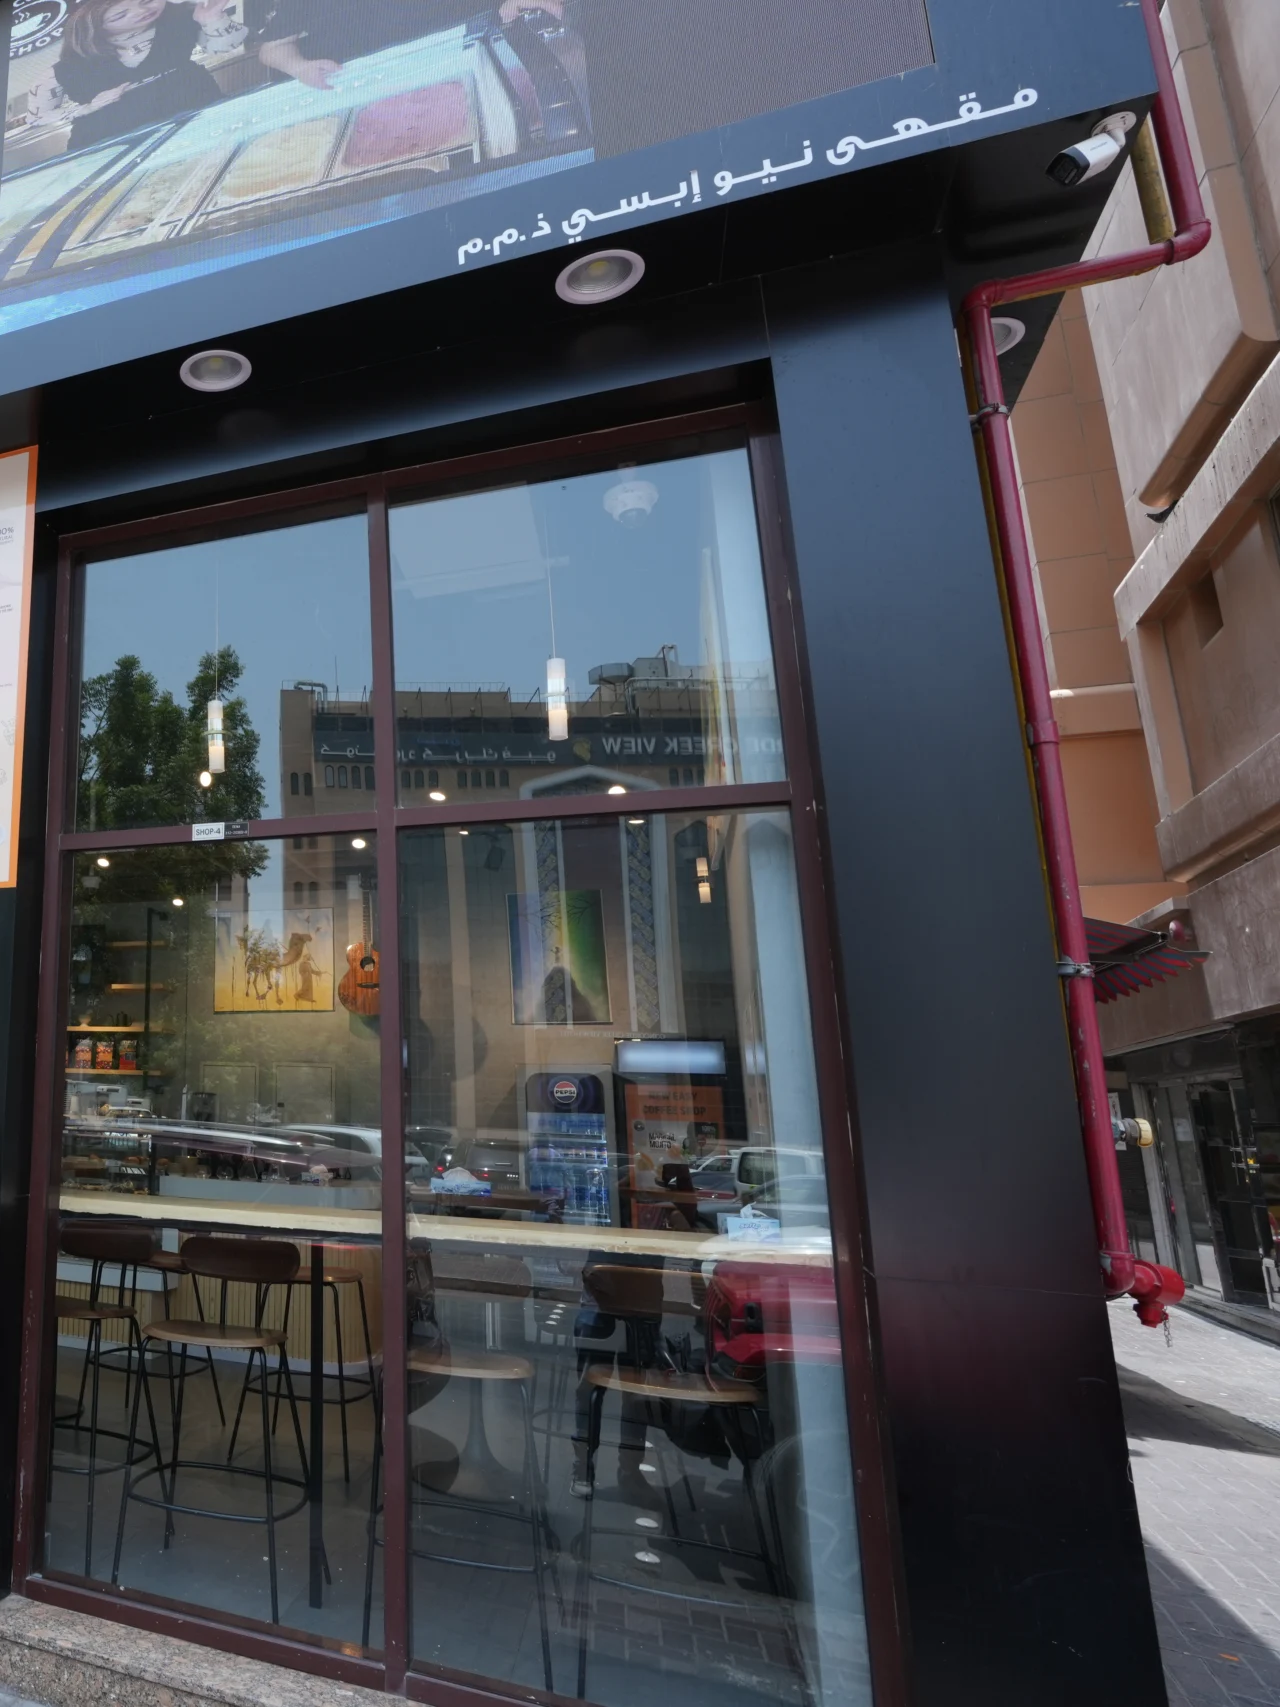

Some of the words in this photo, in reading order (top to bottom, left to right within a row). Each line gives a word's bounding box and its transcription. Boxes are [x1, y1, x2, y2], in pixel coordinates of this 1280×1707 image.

[826, 87, 1039, 167] مقهى
[715, 137, 813, 196] نيو
[562, 169, 702, 244] إبسي
[196, 828, 221, 836] SHOP-4
[643, 1106, 677, 1115] COFFEE
[681, 1106, 707, 1115] SHOP
[672, 1092, 698, 1100] EASY
